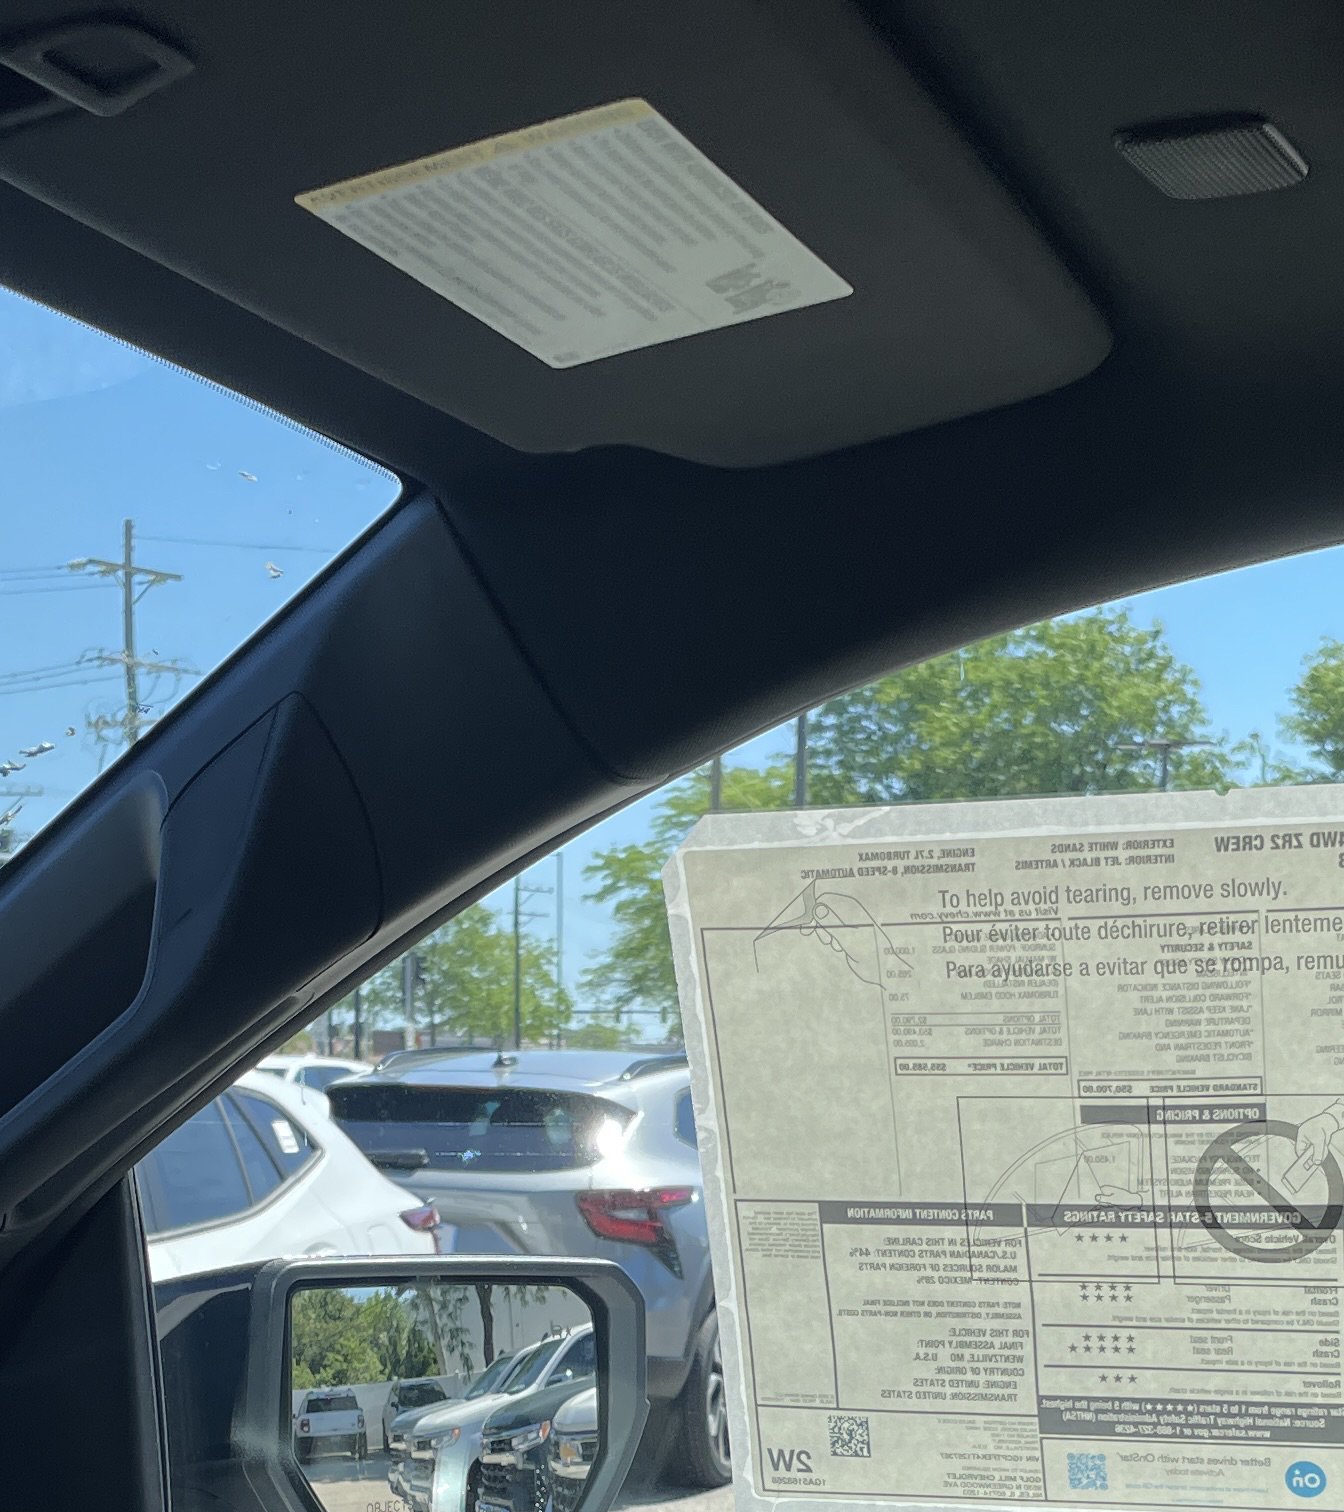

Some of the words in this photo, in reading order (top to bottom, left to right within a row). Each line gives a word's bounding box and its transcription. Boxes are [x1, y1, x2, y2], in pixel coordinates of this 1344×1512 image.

[937, 889, 960, 908] To
[965, 888, 1004, 911] help
[1009, 885, 1059, 906] avoid
[1065, 882, 1136, 909] tearing,
[1143, 881, 1213, 901] remove
[1220, 876, 1287, 902] slowly.
[942, 925, 980, 944] Pour
[986, 922, 1039, 943] éviter
[1045, 921, 1090, 941] toute
[1096, 916, 1192, 943] déchirure,
[1198, 916, 1255, 936] retirer
[944, 960, 984, 979] Para
[991, 958, 1072, 983] ayudarse
[1079, 962, 1088, 976] a
[1095, 956, 1146, 976] evitar
[1152, 959, 1186, 979] que
[1194, 958, 1215, 974] se
[1222, 955, 1288, 977] rompa,
